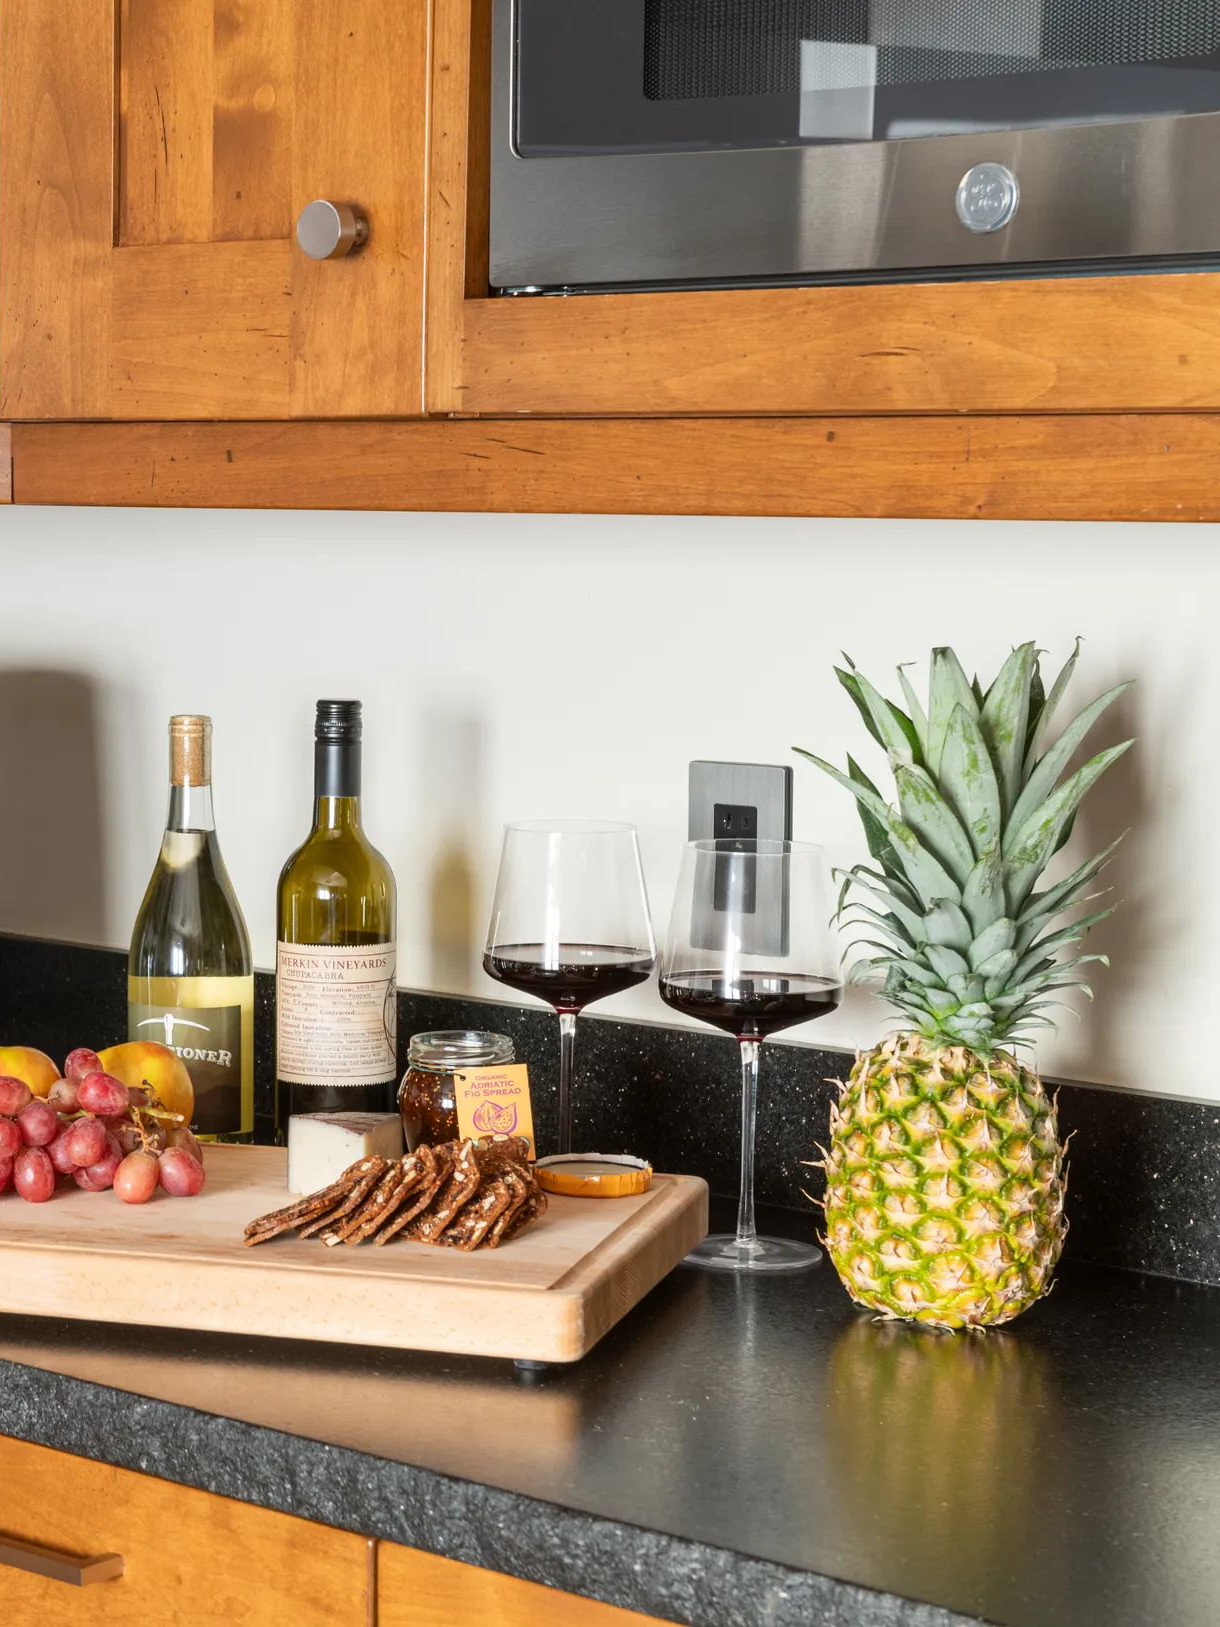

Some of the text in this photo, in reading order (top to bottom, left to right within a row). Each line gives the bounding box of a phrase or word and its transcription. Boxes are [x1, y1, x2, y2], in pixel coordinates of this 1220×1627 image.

[281, 956, 387, 970] MERKIN VINEYARDS
[286, 969, 344, 980] CHUPACABRA
[470, 1080, 514, 1090] ADRIATIC
[464, 1087, 522, 1098] FIG SPREAD
